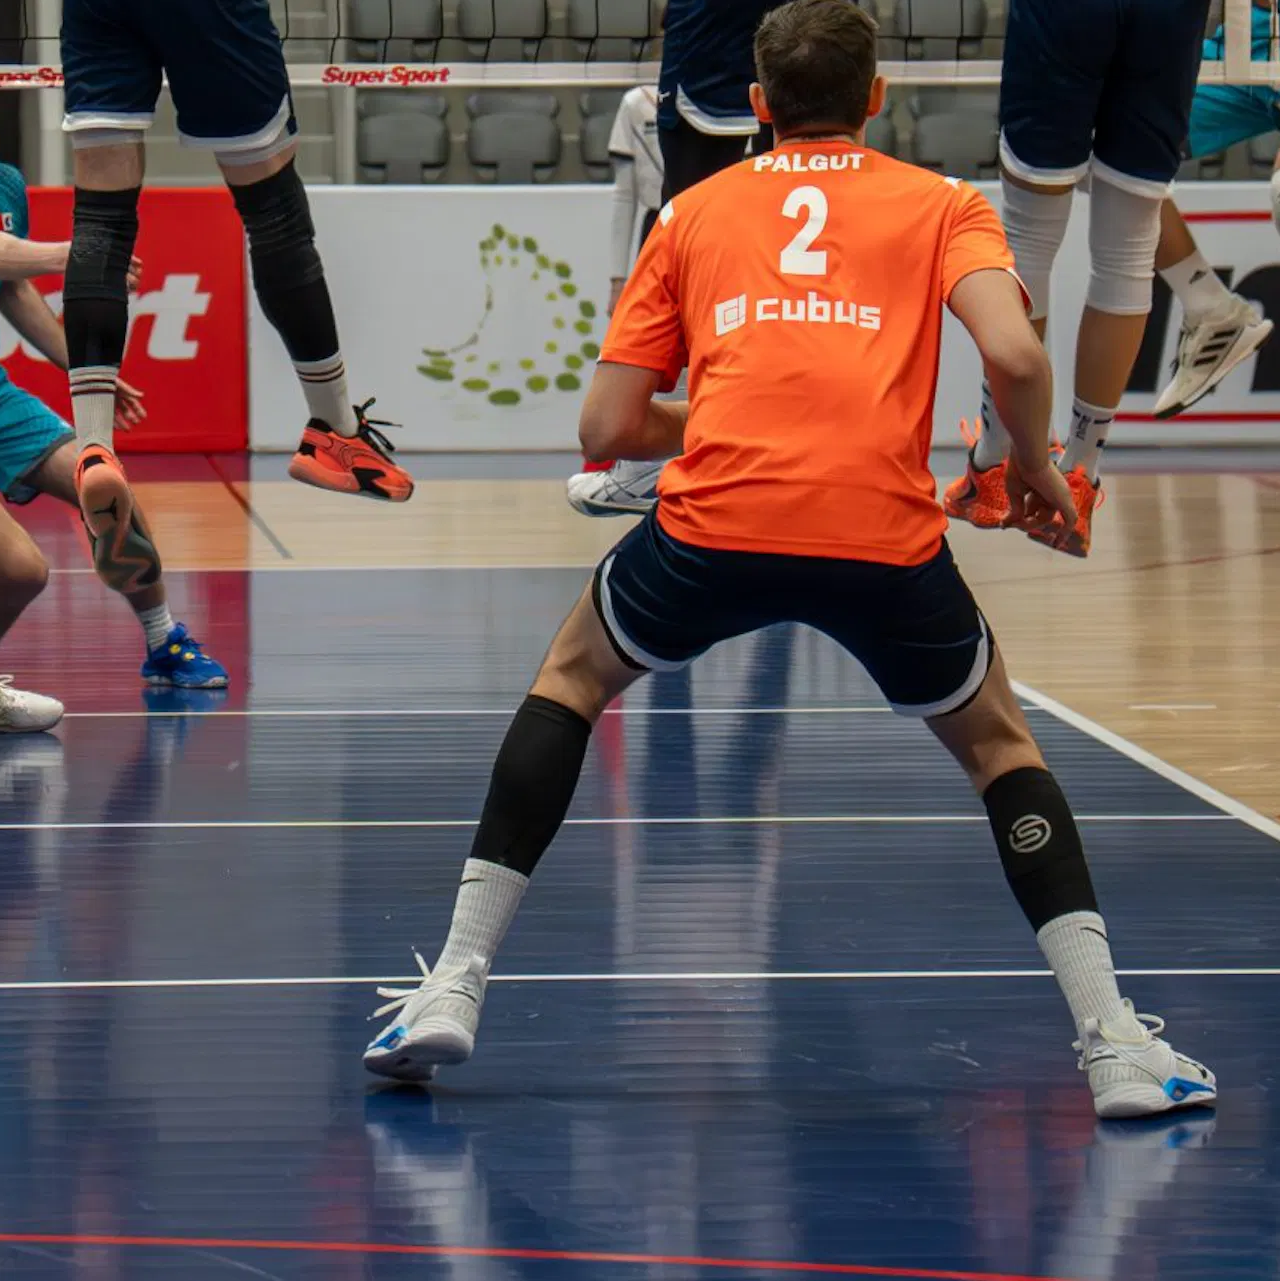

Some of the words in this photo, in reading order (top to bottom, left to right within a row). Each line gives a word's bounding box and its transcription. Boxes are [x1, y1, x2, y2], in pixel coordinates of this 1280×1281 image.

[322, 66, 451, 87] SuperSport
[752, 152, 866, 174] PALGUT
[779, 185, 829, 276] 2
[755, 291, 881, 331] cubus
